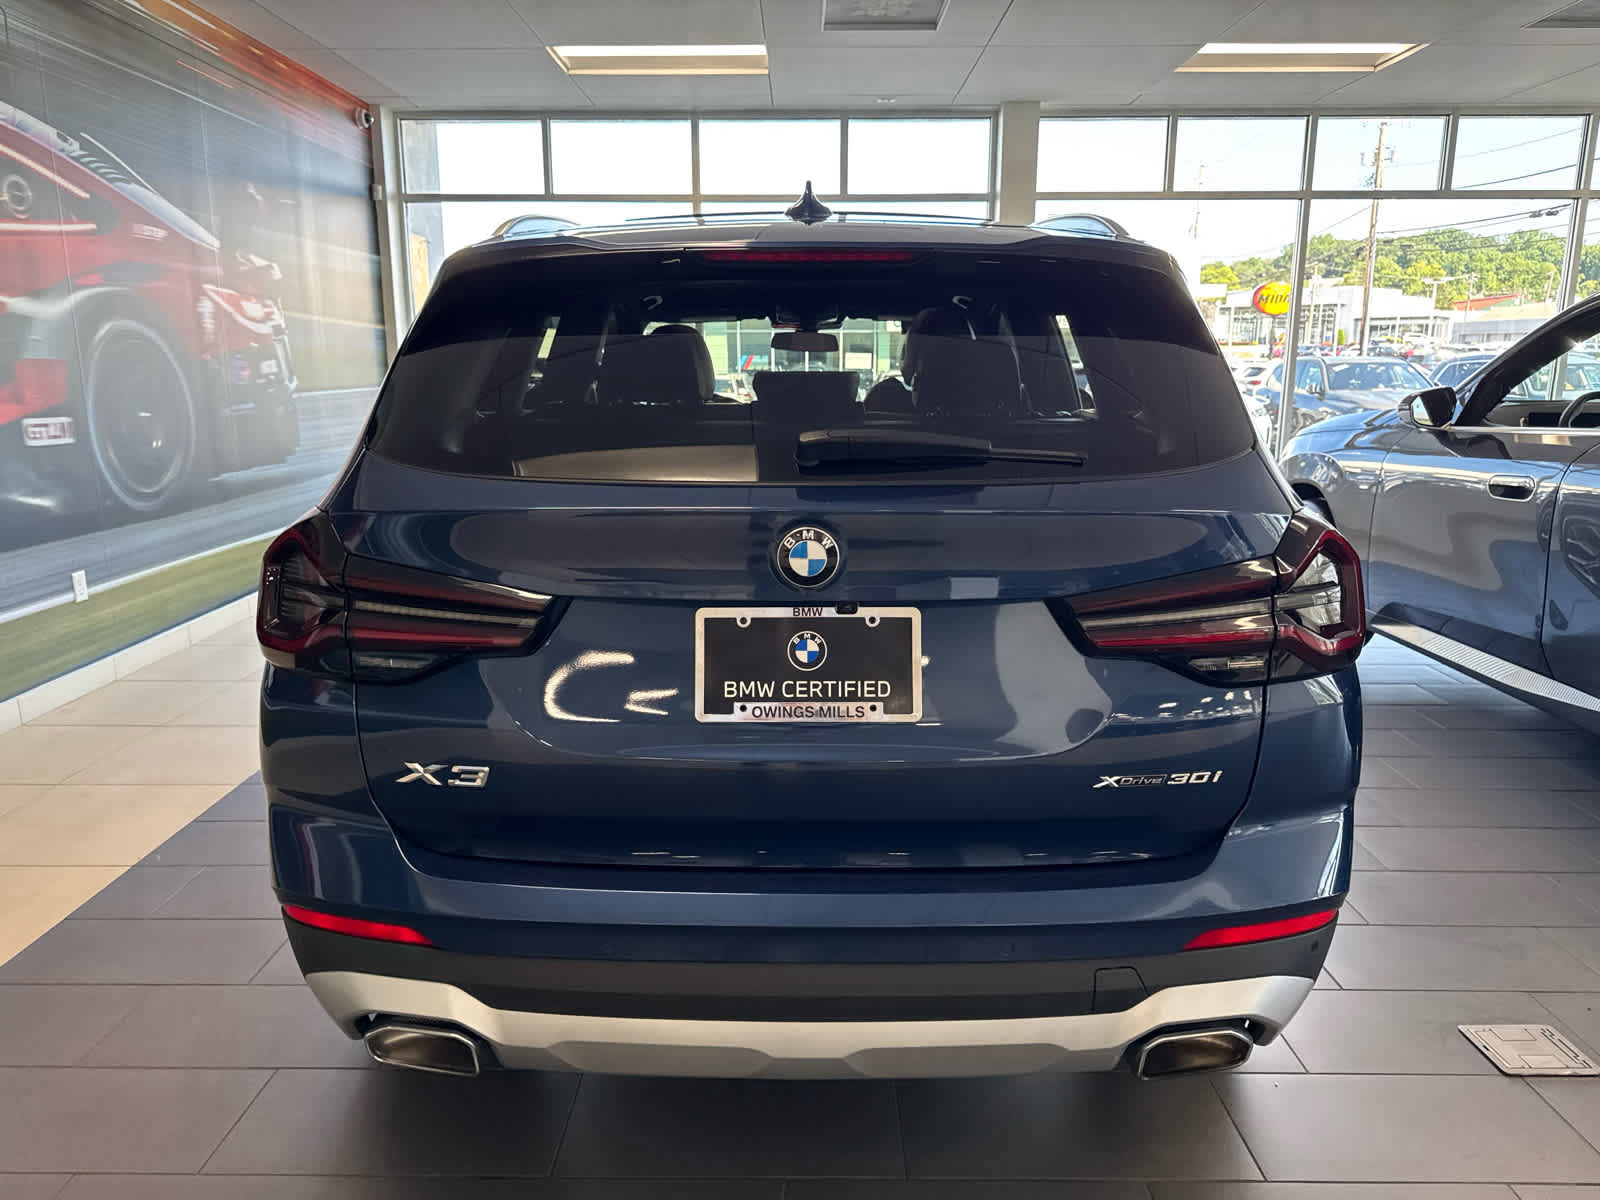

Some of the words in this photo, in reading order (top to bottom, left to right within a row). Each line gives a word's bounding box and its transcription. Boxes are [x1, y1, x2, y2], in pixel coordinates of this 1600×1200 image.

[783, 529, 834, 549] BMW
[792, 607, 823, 617] BMW
[792, 632, 822, 645] BMW
[723, 680, 775, 698] BMW
[781, 680, 891, 698] CERTIFIED
[751, 705, 815, 718] OWINGS
[818, 705, 865, 718] MILLS
[396, 762, 490, 788] X3
